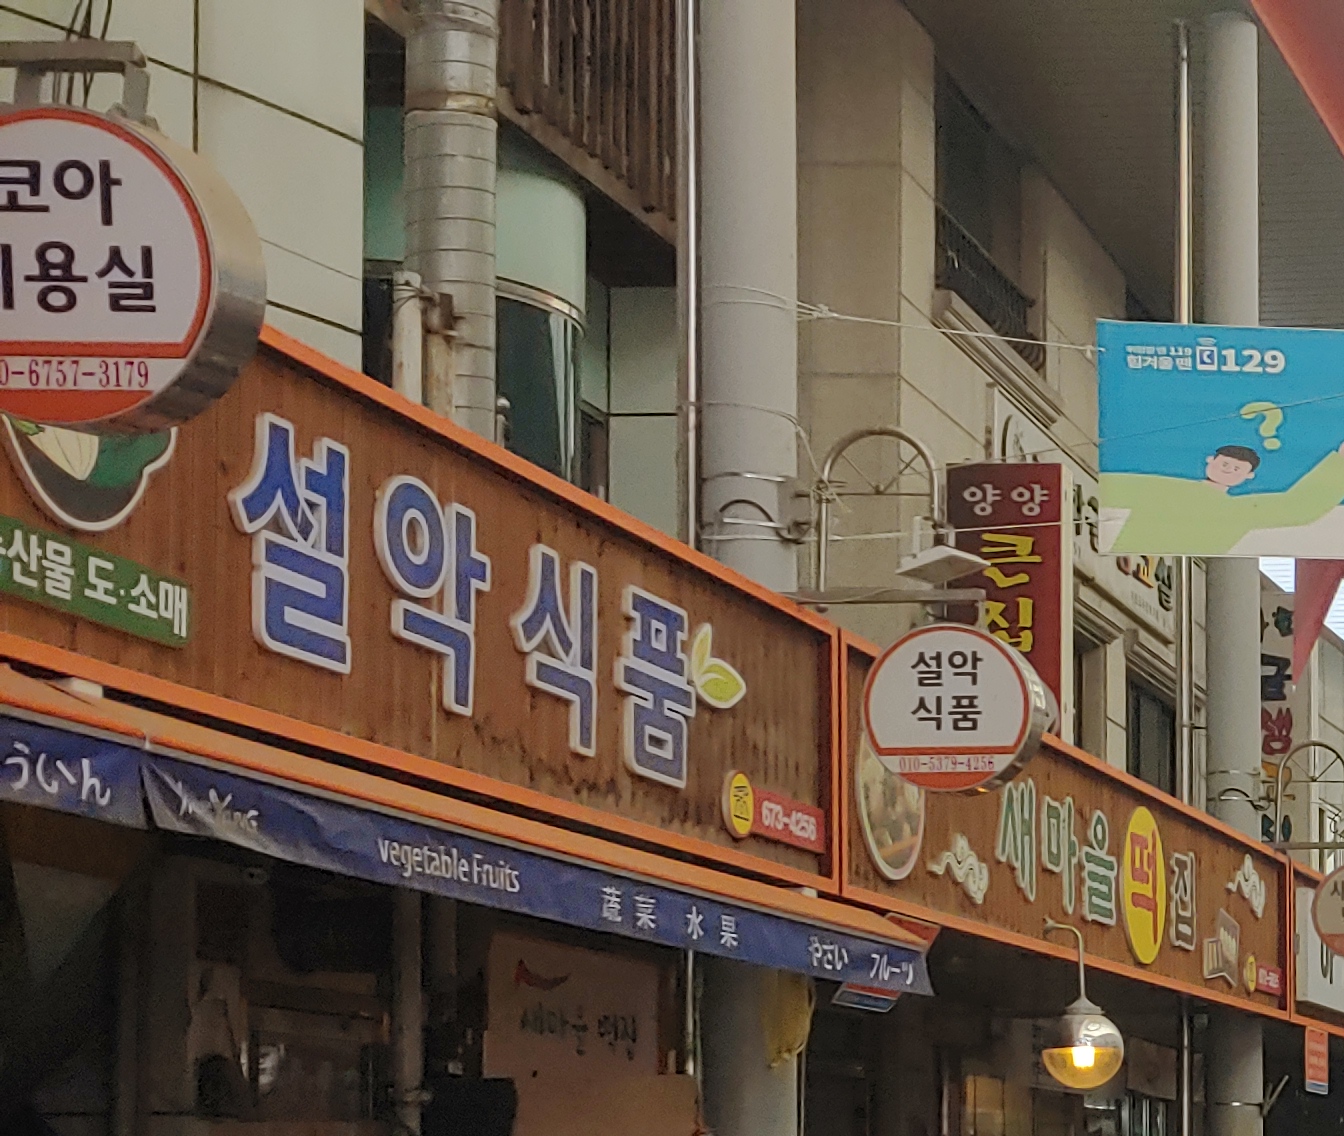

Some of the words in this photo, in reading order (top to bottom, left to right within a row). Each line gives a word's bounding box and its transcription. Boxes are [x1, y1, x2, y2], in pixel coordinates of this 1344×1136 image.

[0, 240, 157, 316] 용실
[1220, 348, 1287, 374] 129
[0, 527, 74, 601] 산물
[910, 649, 984, 688] 설악
[910, 693, 983, 732] 식품
[898, 755, 996, 772] 010-5379-4256
[996, 777, 1118, 927] 새마을
[472, 852, 521, 894] Fruits
